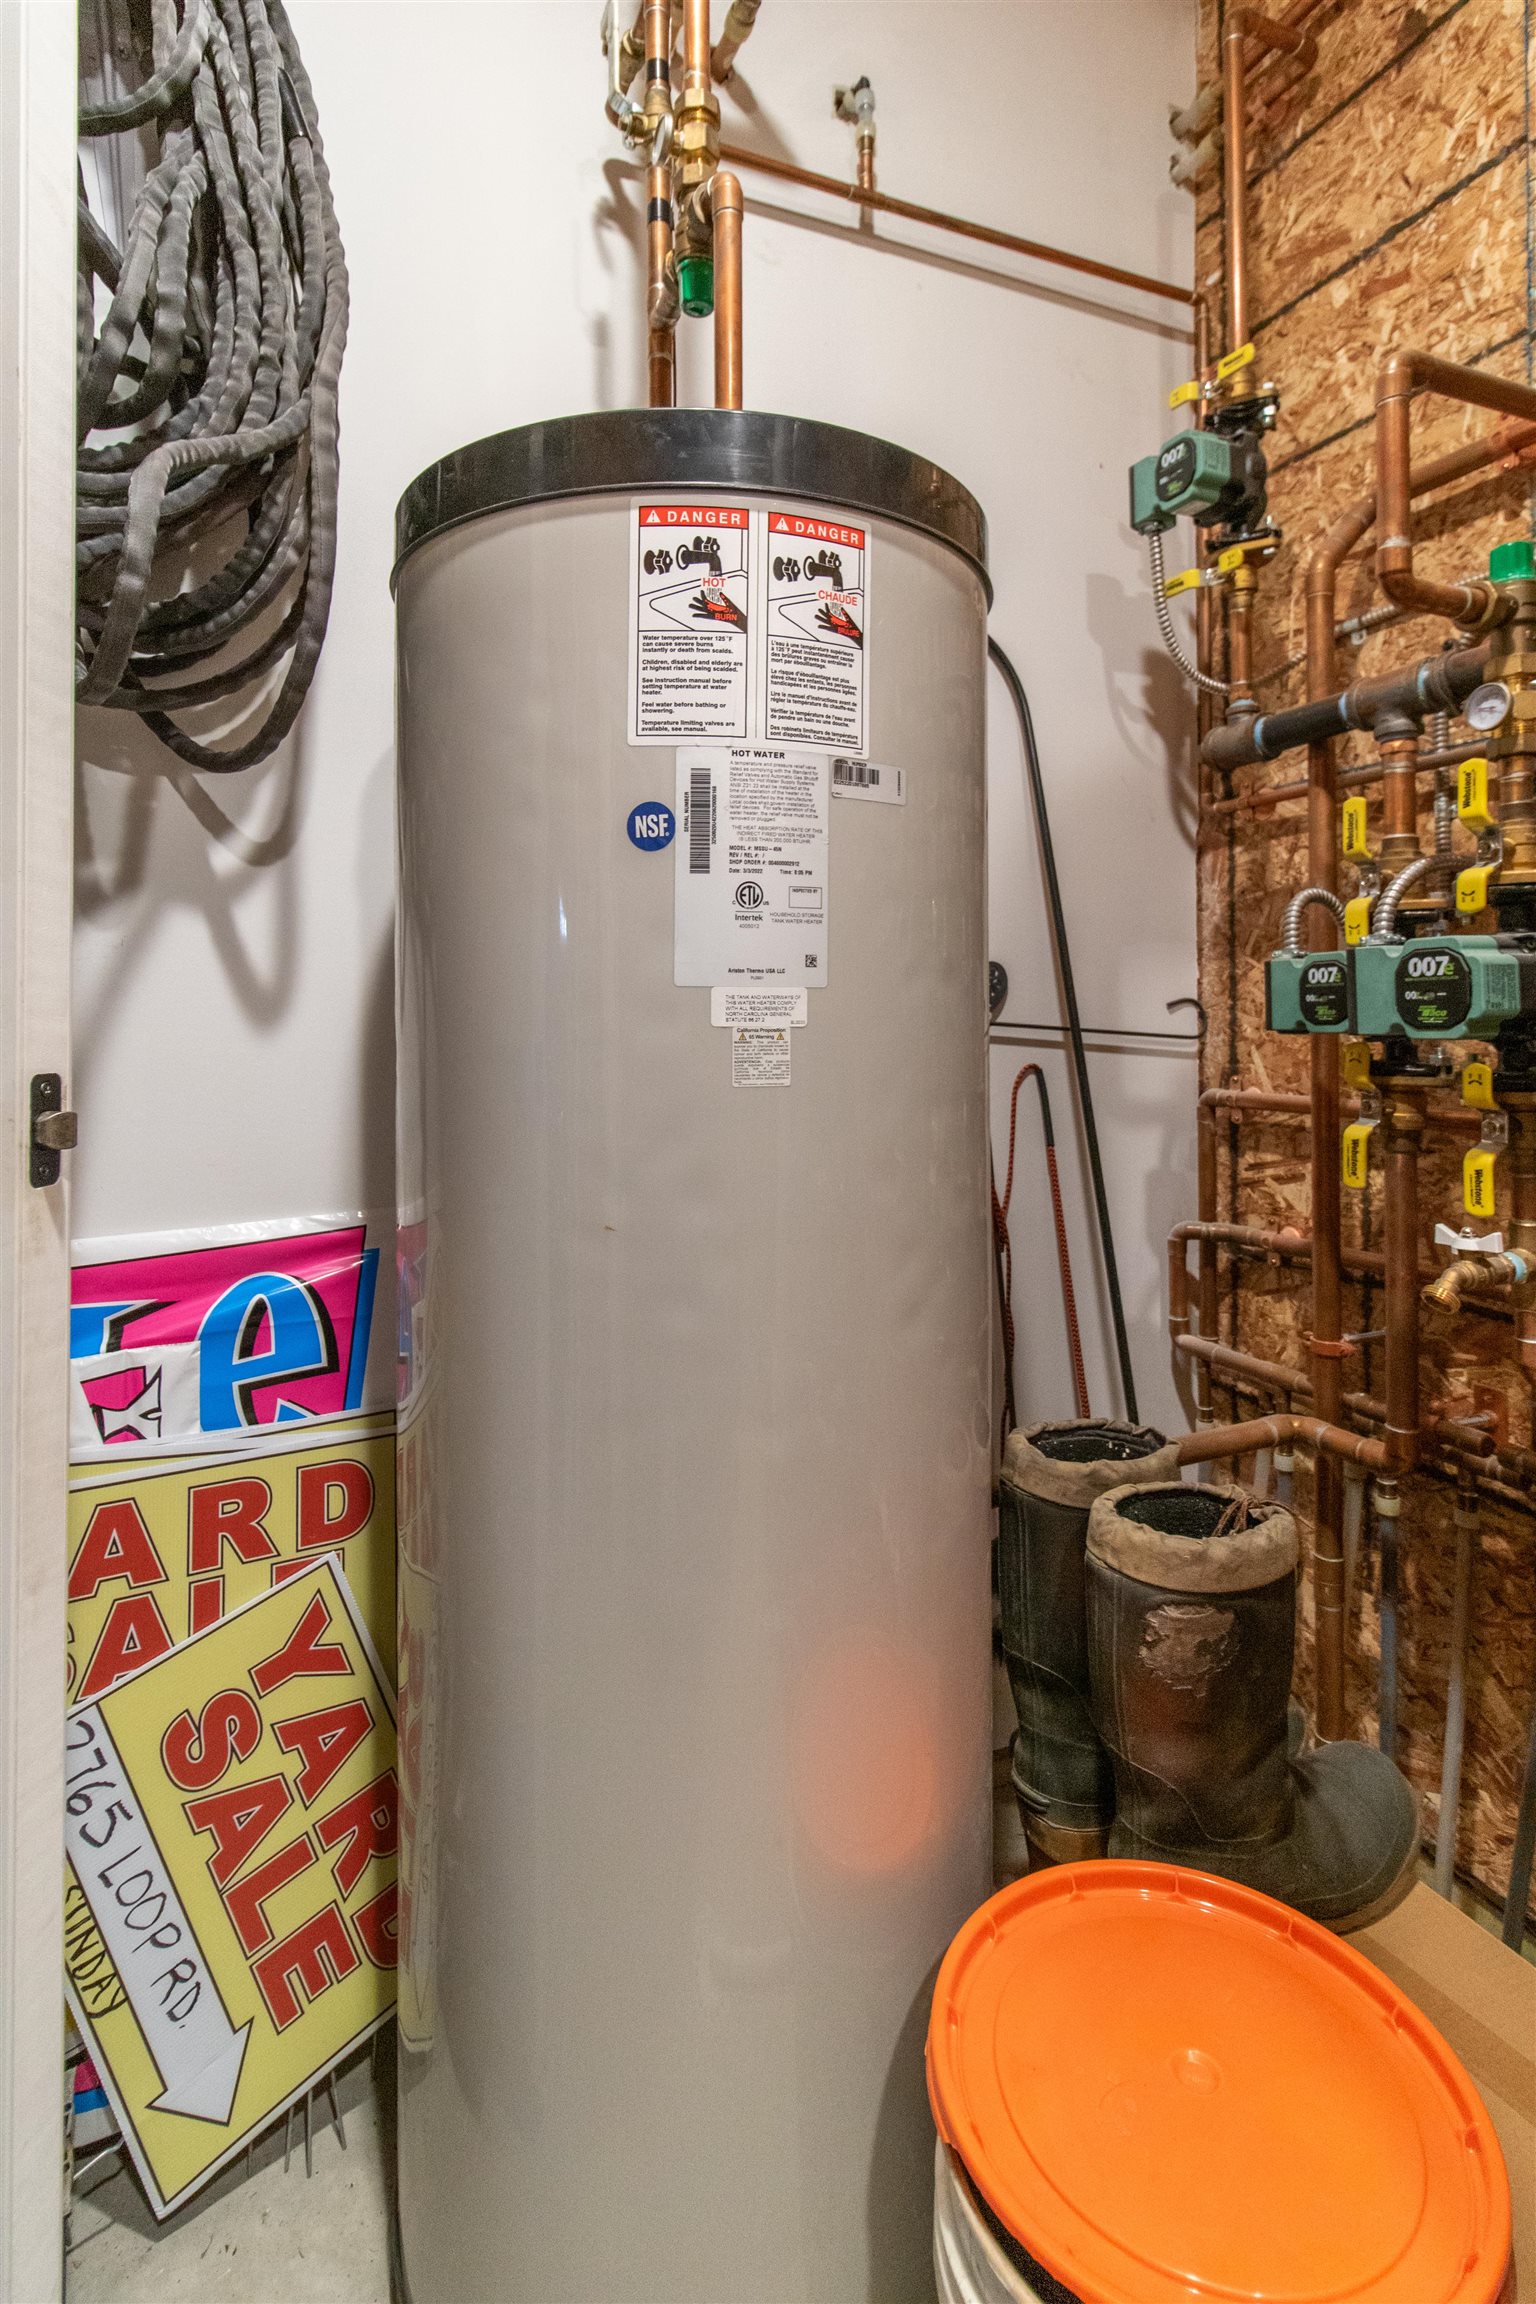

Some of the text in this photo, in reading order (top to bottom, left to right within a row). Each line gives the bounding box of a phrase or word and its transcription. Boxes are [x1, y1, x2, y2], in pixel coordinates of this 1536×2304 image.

[667, 511, 742, 525] DANGER
[795, 522, 860, 545] DANGER
[702, 577, 727, 588] HOT
[818, 590, 858, 606] CHAUDE
[714, 613, 738, 621] BURN
[753, 751, 785, 759] WATER
[1462, 772, 1472, 809] Webstone
[634, 813, 670, 839] NSF
[1351, 1139, 1360, 1176] Webstone
[1474, 1169, 1483, 1206] Webstone
[68, 1459, 375, 1603] ARD
[160, 1688, 362, 2036] SALE
[98, 1845, 182, 1953] LOOP
